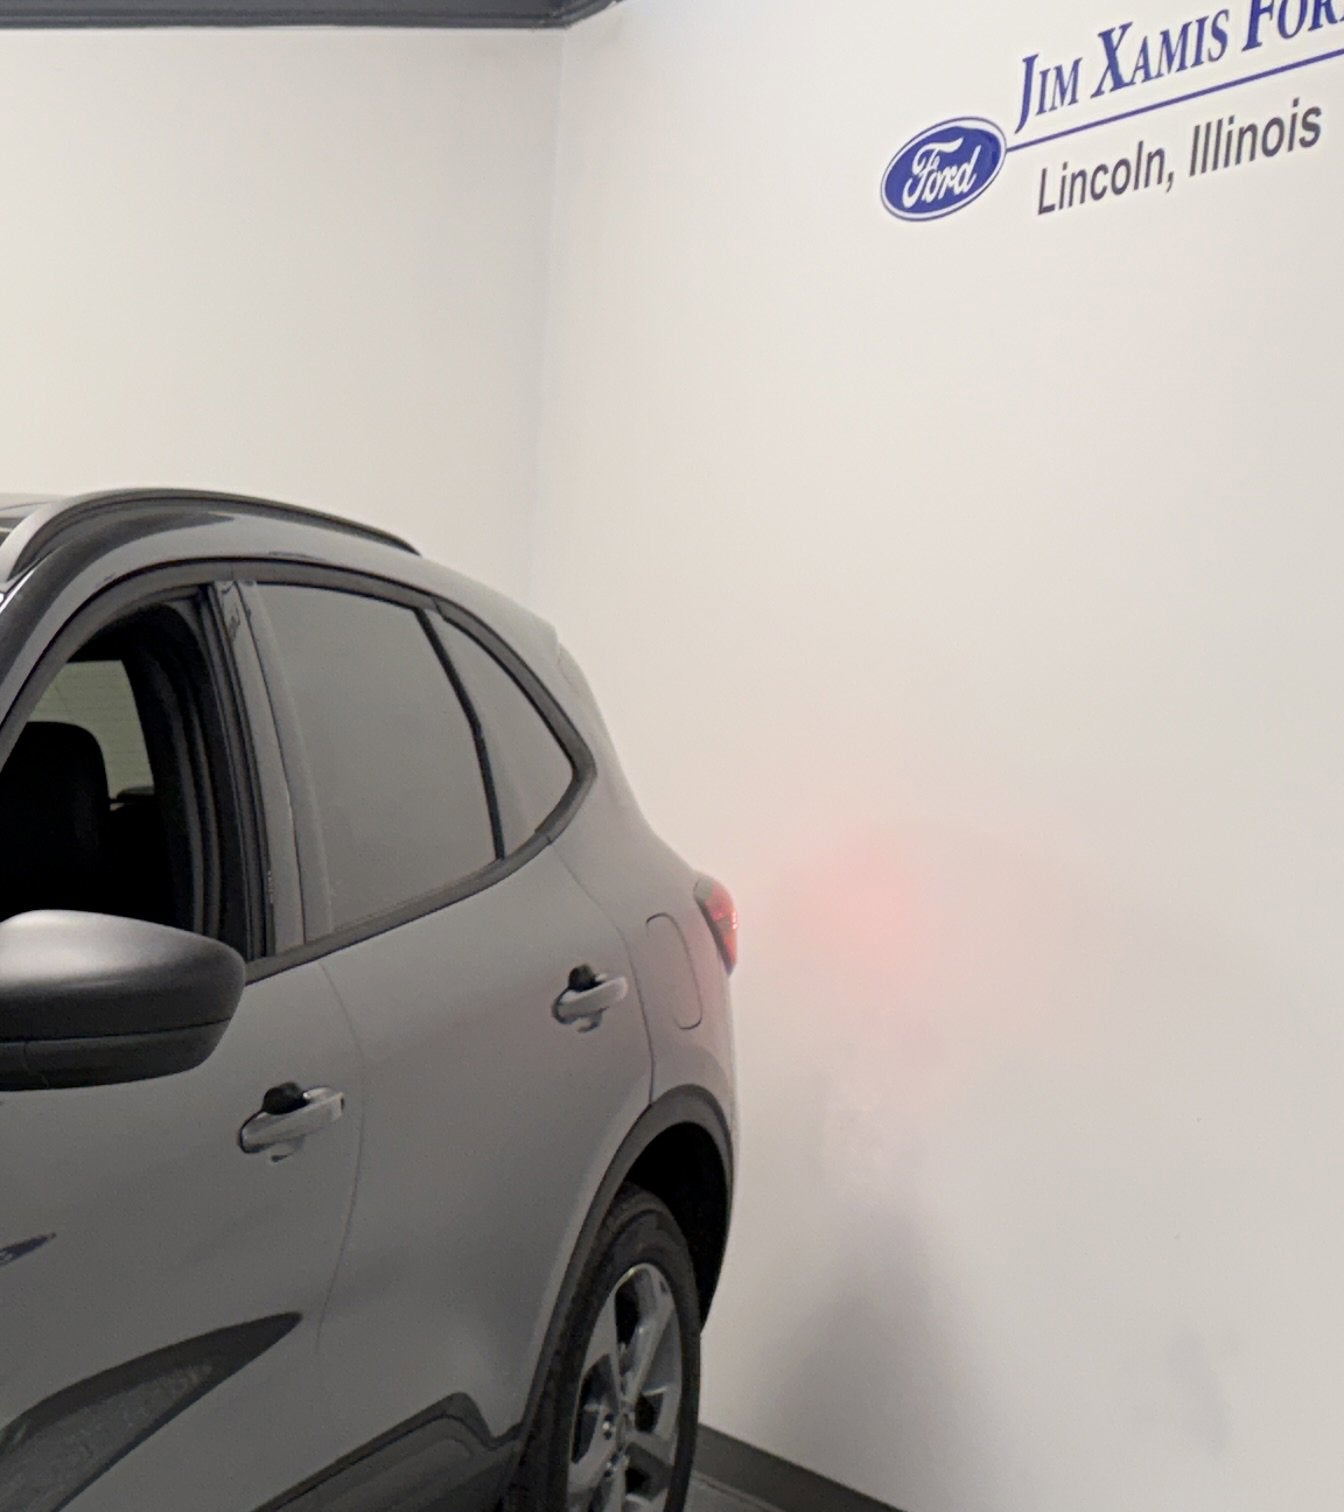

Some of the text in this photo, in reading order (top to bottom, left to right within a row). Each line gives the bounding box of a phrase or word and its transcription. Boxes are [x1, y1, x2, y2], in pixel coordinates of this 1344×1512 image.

[1016, 0, 1344, 134] JIM XAMIS FOR
[902, 137, 981, 208] Ford
[1038, 98, 1322, 215] Lincoln, Illinois
